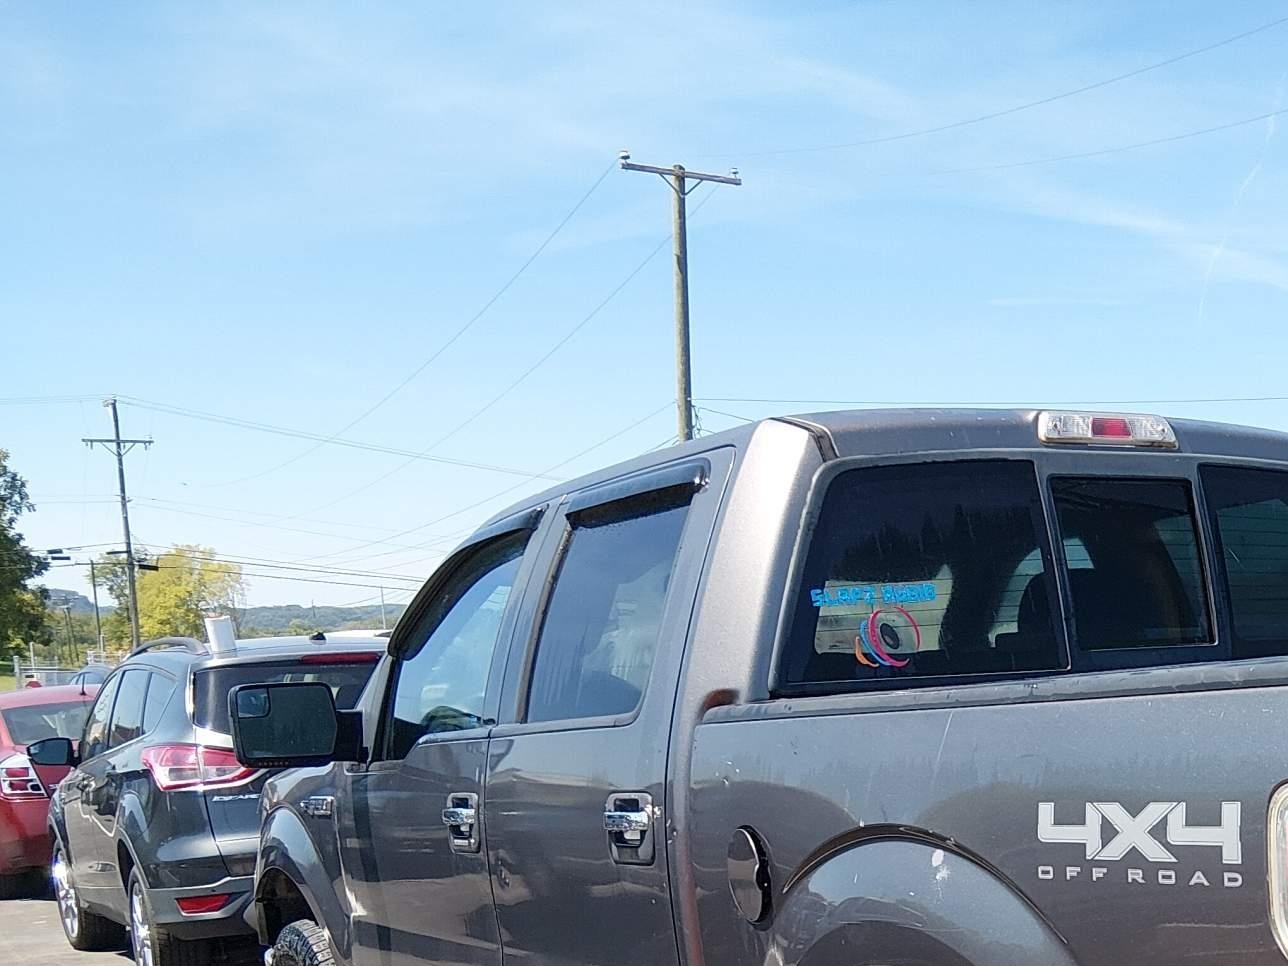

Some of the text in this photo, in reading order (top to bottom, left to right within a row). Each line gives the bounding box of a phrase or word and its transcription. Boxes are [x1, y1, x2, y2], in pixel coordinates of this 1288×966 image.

[1038, 801, 1242, 864] 4X4
[1037, 865, 1244, 888] OFF ROAD
